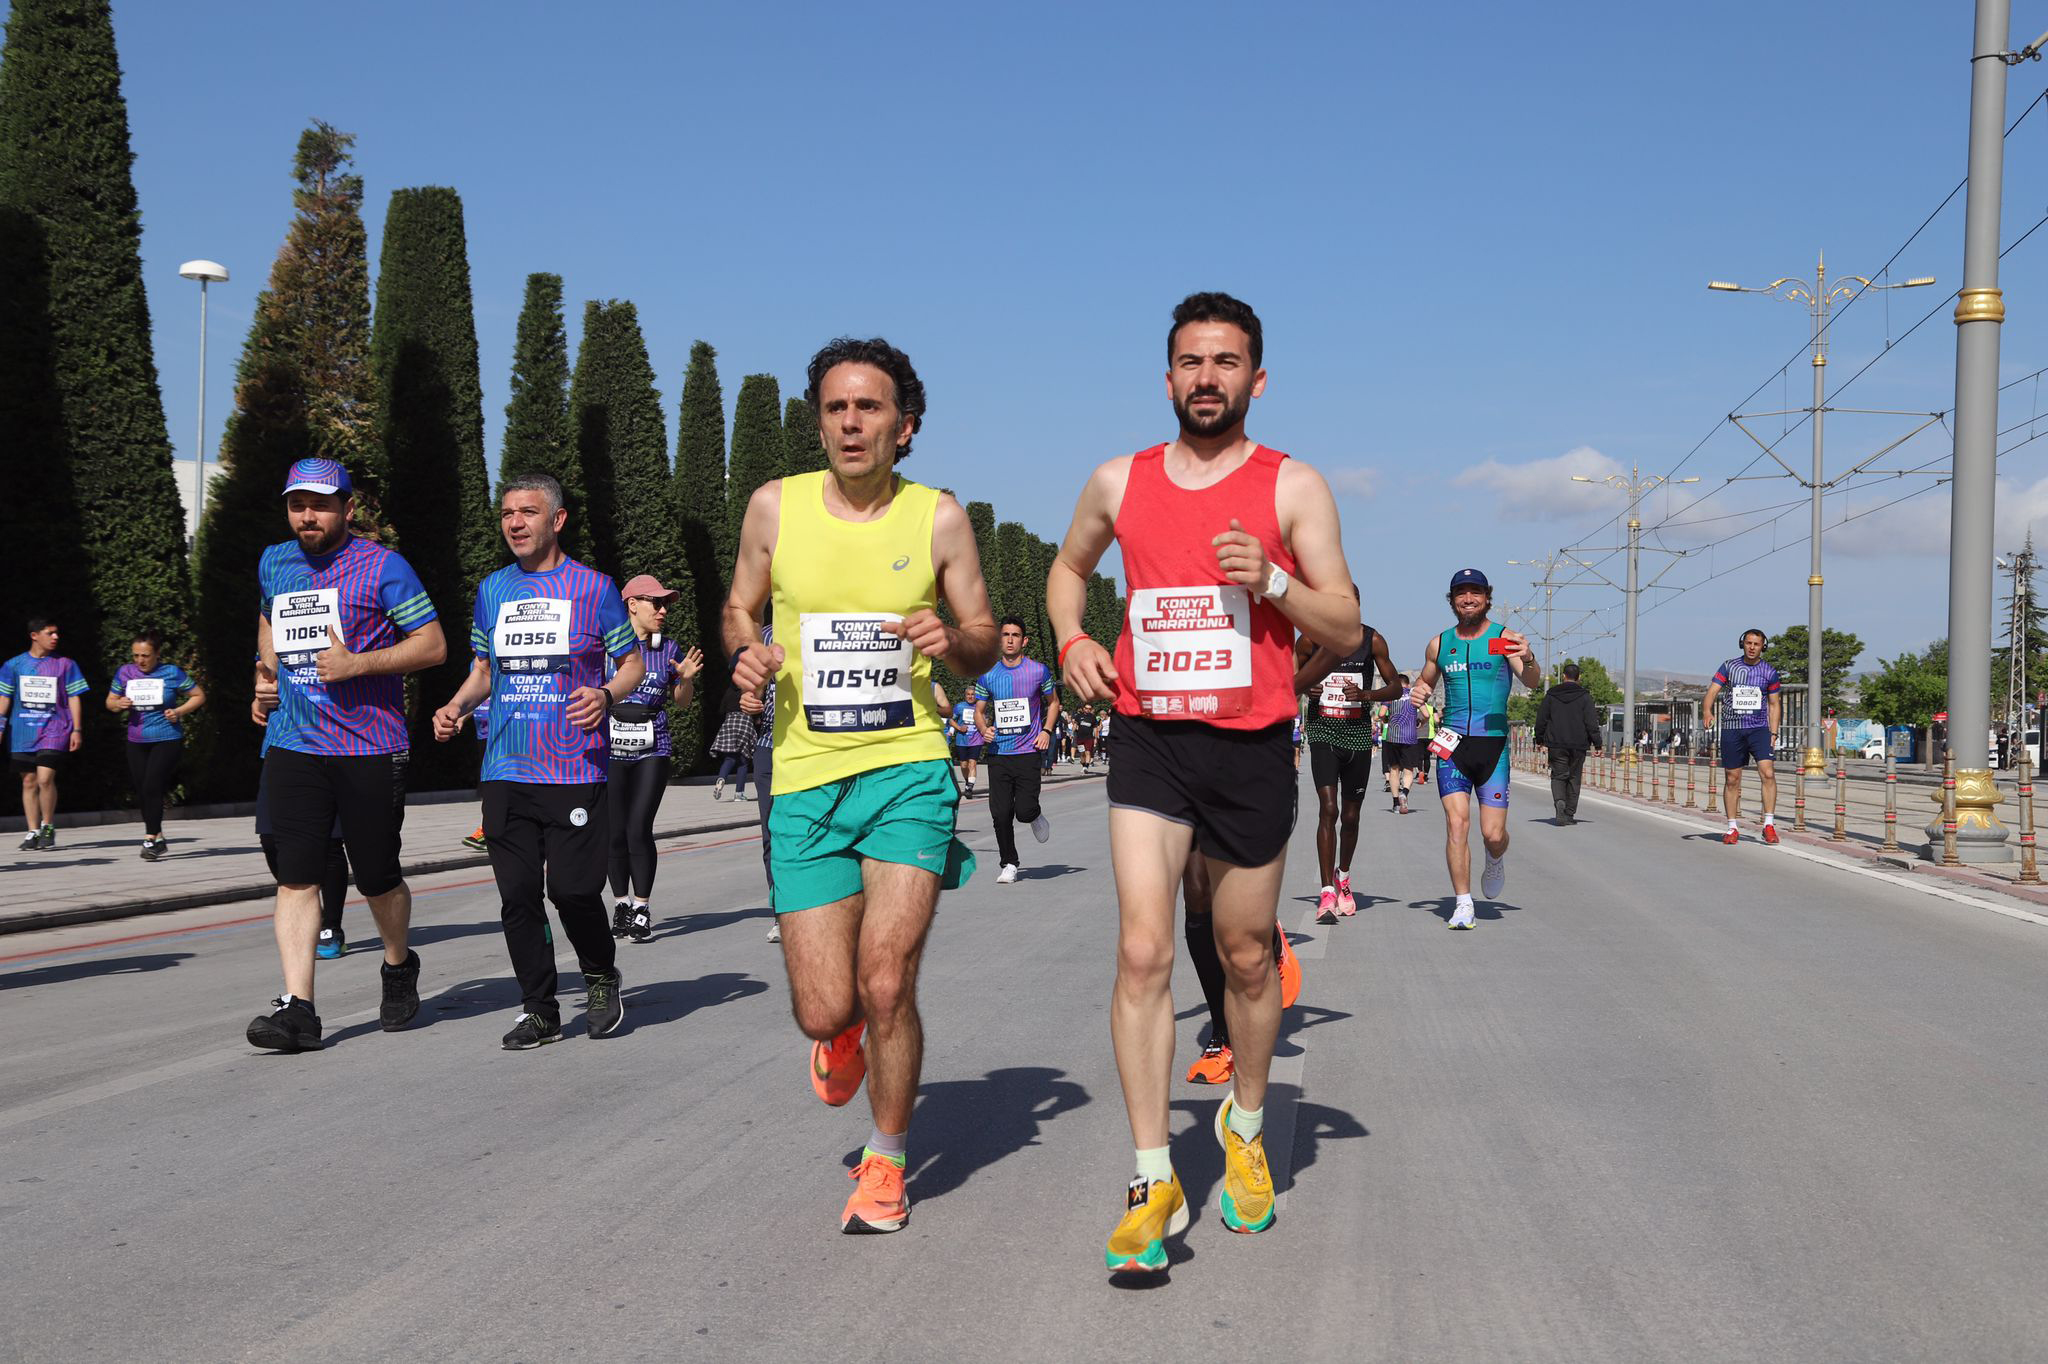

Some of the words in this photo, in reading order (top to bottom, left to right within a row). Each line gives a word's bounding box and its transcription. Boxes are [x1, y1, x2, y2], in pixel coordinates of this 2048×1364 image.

[290, 595, 318, 604] KONYA
[1159, 598, 1210, 609] KONYA
[282, 606, 328, 617] MARATONU
[1167, 608, 1202, 619] YARI
[507, 614, 558, 622] MARATONU
[1146, 617, 1229, 630] MARATONU
[286, 624, 328, 641] 11064
[842, 631, 876, 641] YARI
[505, 632, 557, 646] 10356
[819, 640, 897, 650] MARATONU
[1147, 649, 1232, 672] 21023
[509, 675, 552, 685] KONYA
[817, 668, 898, 688] 10548
[514, 684, 544, 693] YARI
[501, 693, 567, 703] MARATONU
[1000, 714, 1025, 723] 10752
[611, 737, 646, 747] 10223
